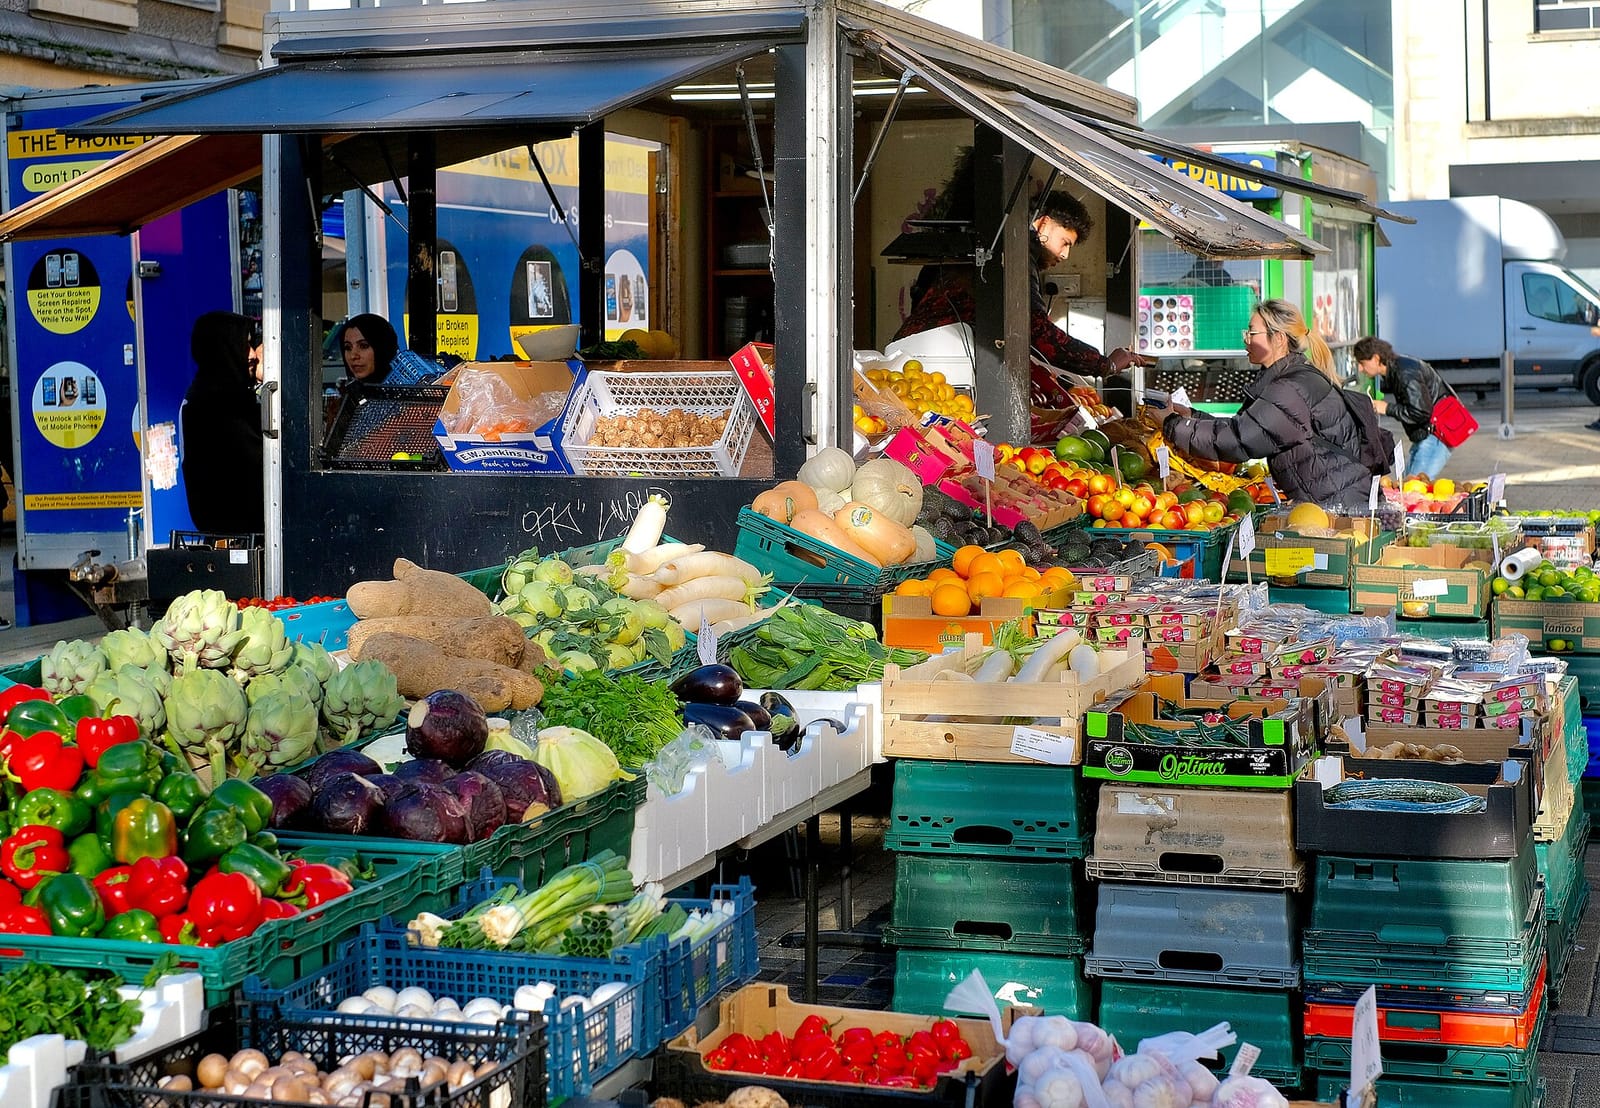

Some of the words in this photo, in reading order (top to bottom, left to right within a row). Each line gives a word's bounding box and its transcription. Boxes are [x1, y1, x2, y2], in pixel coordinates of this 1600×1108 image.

[19, 134, 57, 153] THE
[33, 170, 67, 184] Don't
[37, 299, 60, 307] Screen
[61, 298, 91, 307] Repaired
[446, 319, 469, 331] Broken
[440, 334, 470, 348] Repaired
[524, 453, 544, 462] Ltd
[1543, 622, 1583, 633] famosa
[1158, 752, 1227, 780] Optima
